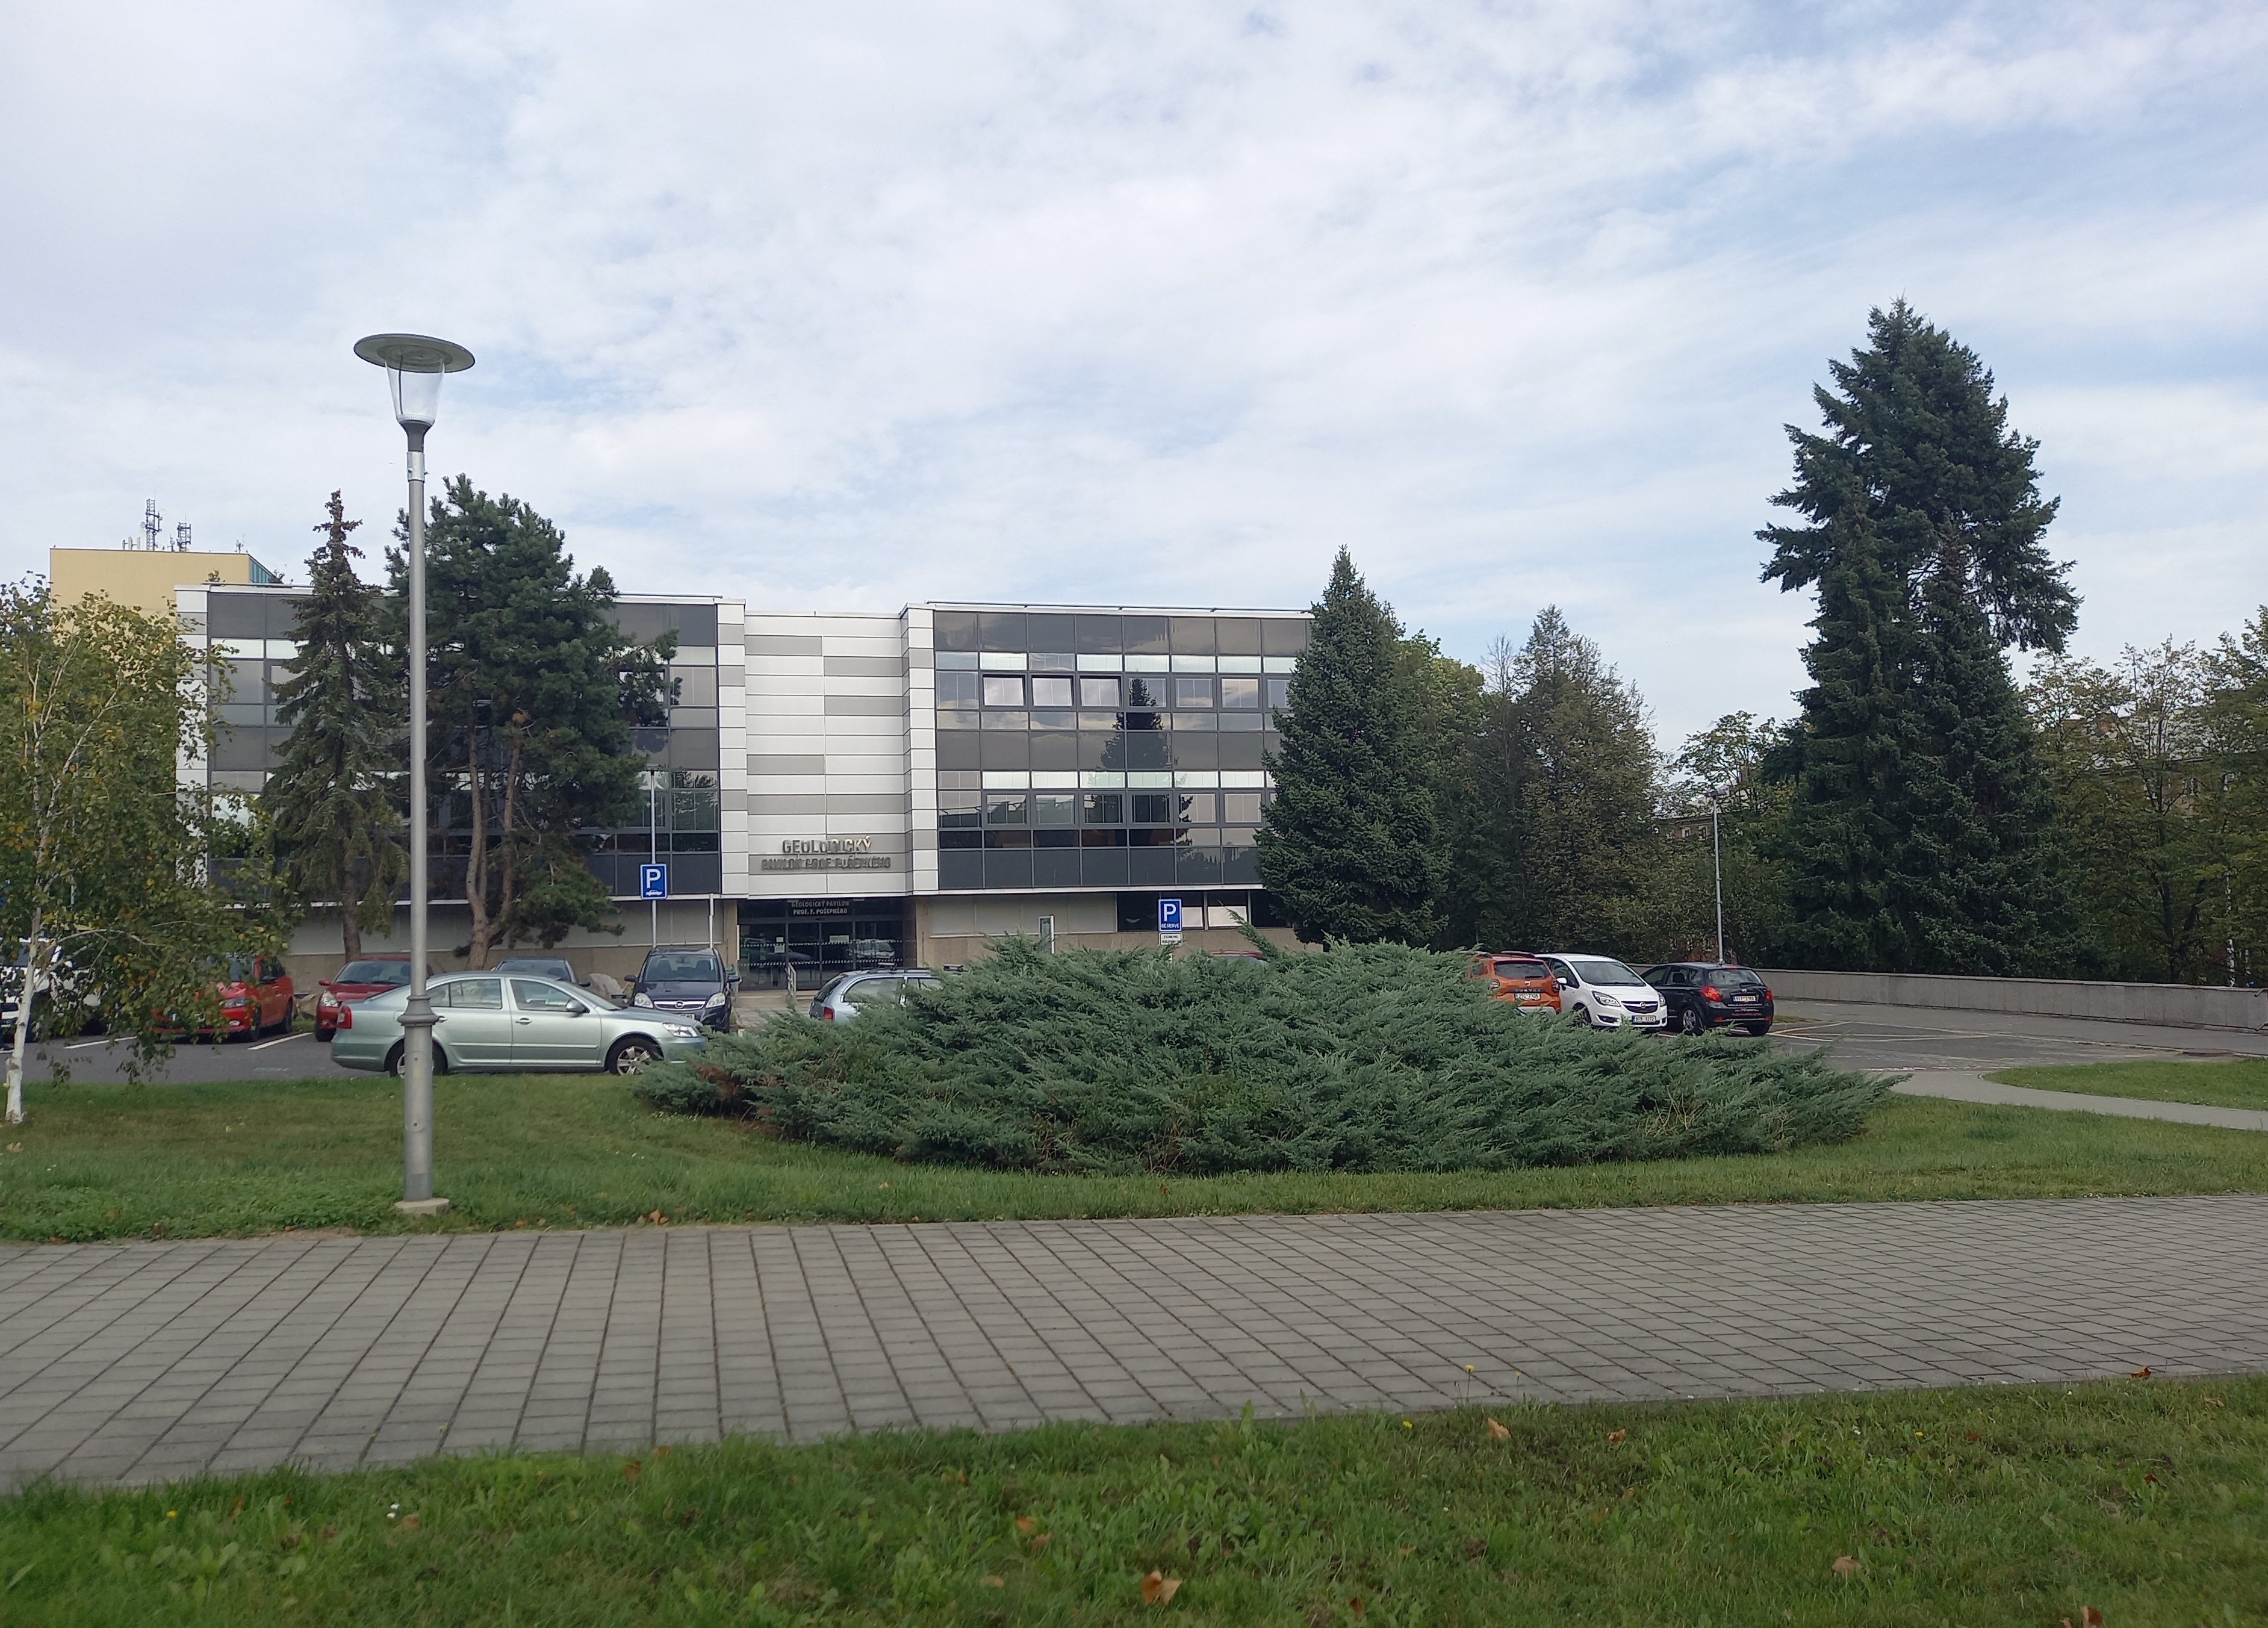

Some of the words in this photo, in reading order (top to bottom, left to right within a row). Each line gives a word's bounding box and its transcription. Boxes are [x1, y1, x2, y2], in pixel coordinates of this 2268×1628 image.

[782, 835, 872, 854] GEOLOGICKÝ
[646, 868, 660, 889] P
[1163, 903, 1176, 922] P
